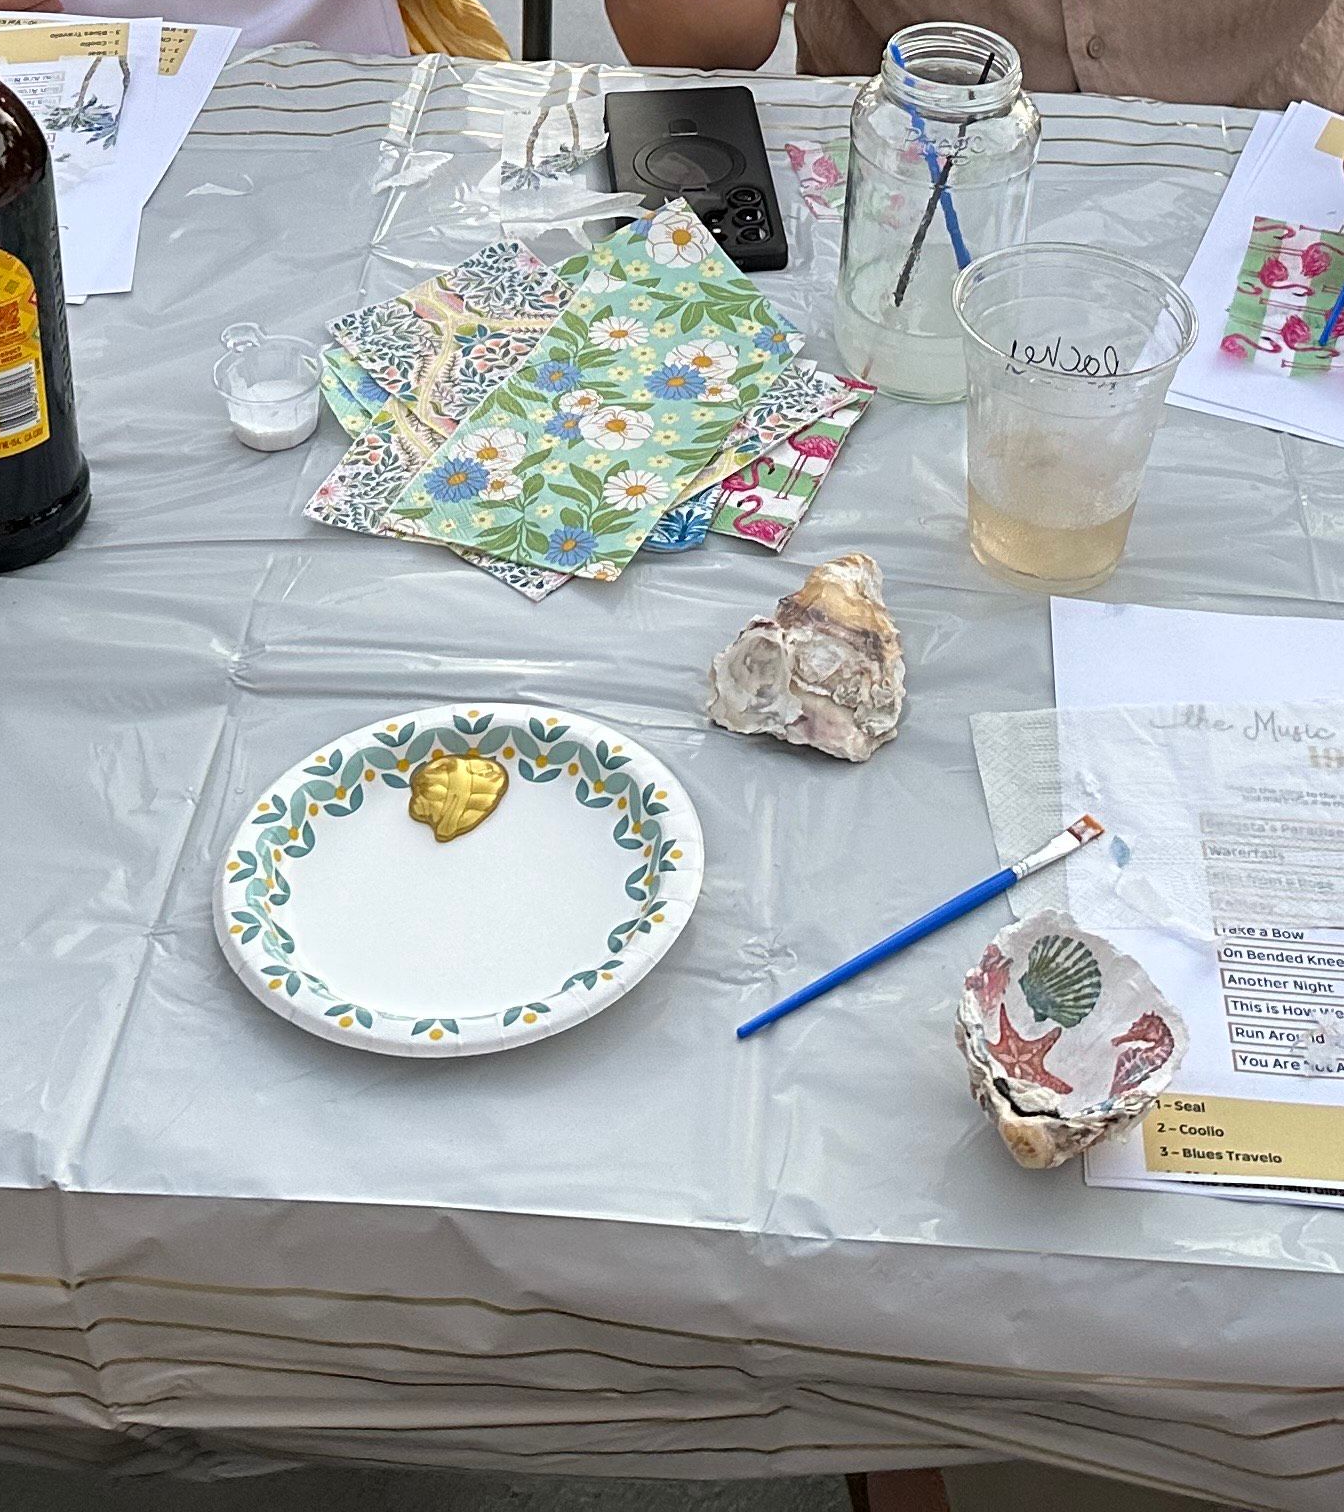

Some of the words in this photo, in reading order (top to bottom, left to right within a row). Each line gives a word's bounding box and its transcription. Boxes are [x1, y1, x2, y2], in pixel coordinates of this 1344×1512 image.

[1243, 710, 1336, 742] Music
[1272, 928, 1304, 939] Bow
[1223, 947, 1243, 959] On
[1247, 949, 1304, 964] Bended
[1228, 974, 1289, 989] Another
[1294, 981, 1334, 994] Night
[1231, 1000, 1262, 1013] This
[1235, 1027, 1264, 1039] Run
[1269, 1029, 1325, 1044] Arod
[1239, 1055, 1268, 1068] You
[1273, 1058, 1300, 1070] Are
[1174, 1100, 1206, 1113] Seal
[1157, 1122, 1166, 1133] 2
[1179, 1123, 1224, 1137] Coolio
[1160, 1146, 1169, 1157] 3
[1182, 1148, 1223, 1160] Blues
[1225, 1150, 1282, 1164] Travelo
